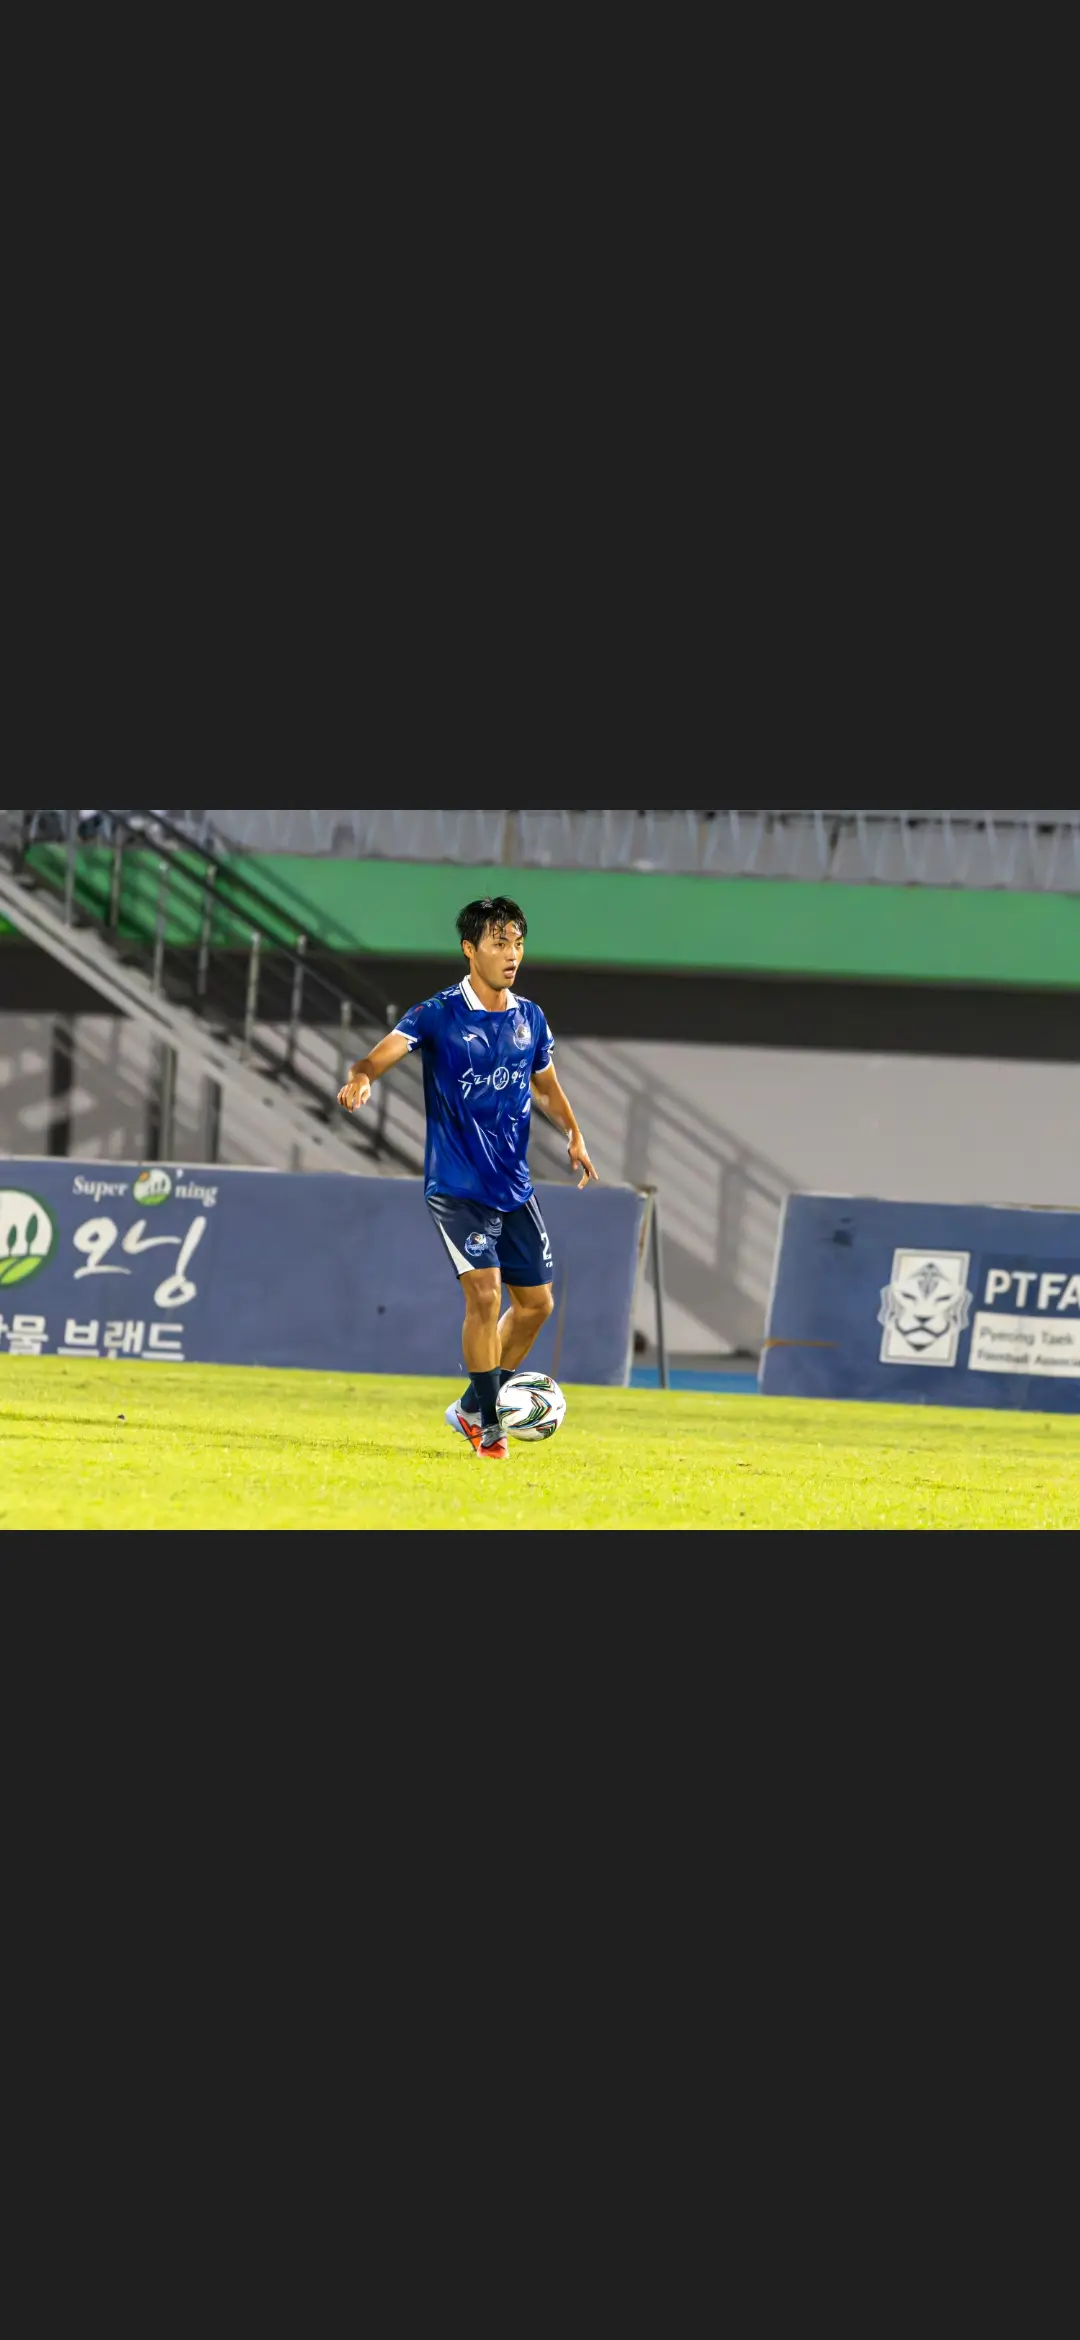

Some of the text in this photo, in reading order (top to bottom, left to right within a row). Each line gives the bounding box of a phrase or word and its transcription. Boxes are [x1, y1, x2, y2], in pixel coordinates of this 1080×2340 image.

[72, 1175, 129, 1203] Super
[72, 1215, 207, 1309] 오닝
[984, 1268, 1080, 1311] PTFA
[57, 1318, 185, 1361] 브랜드
